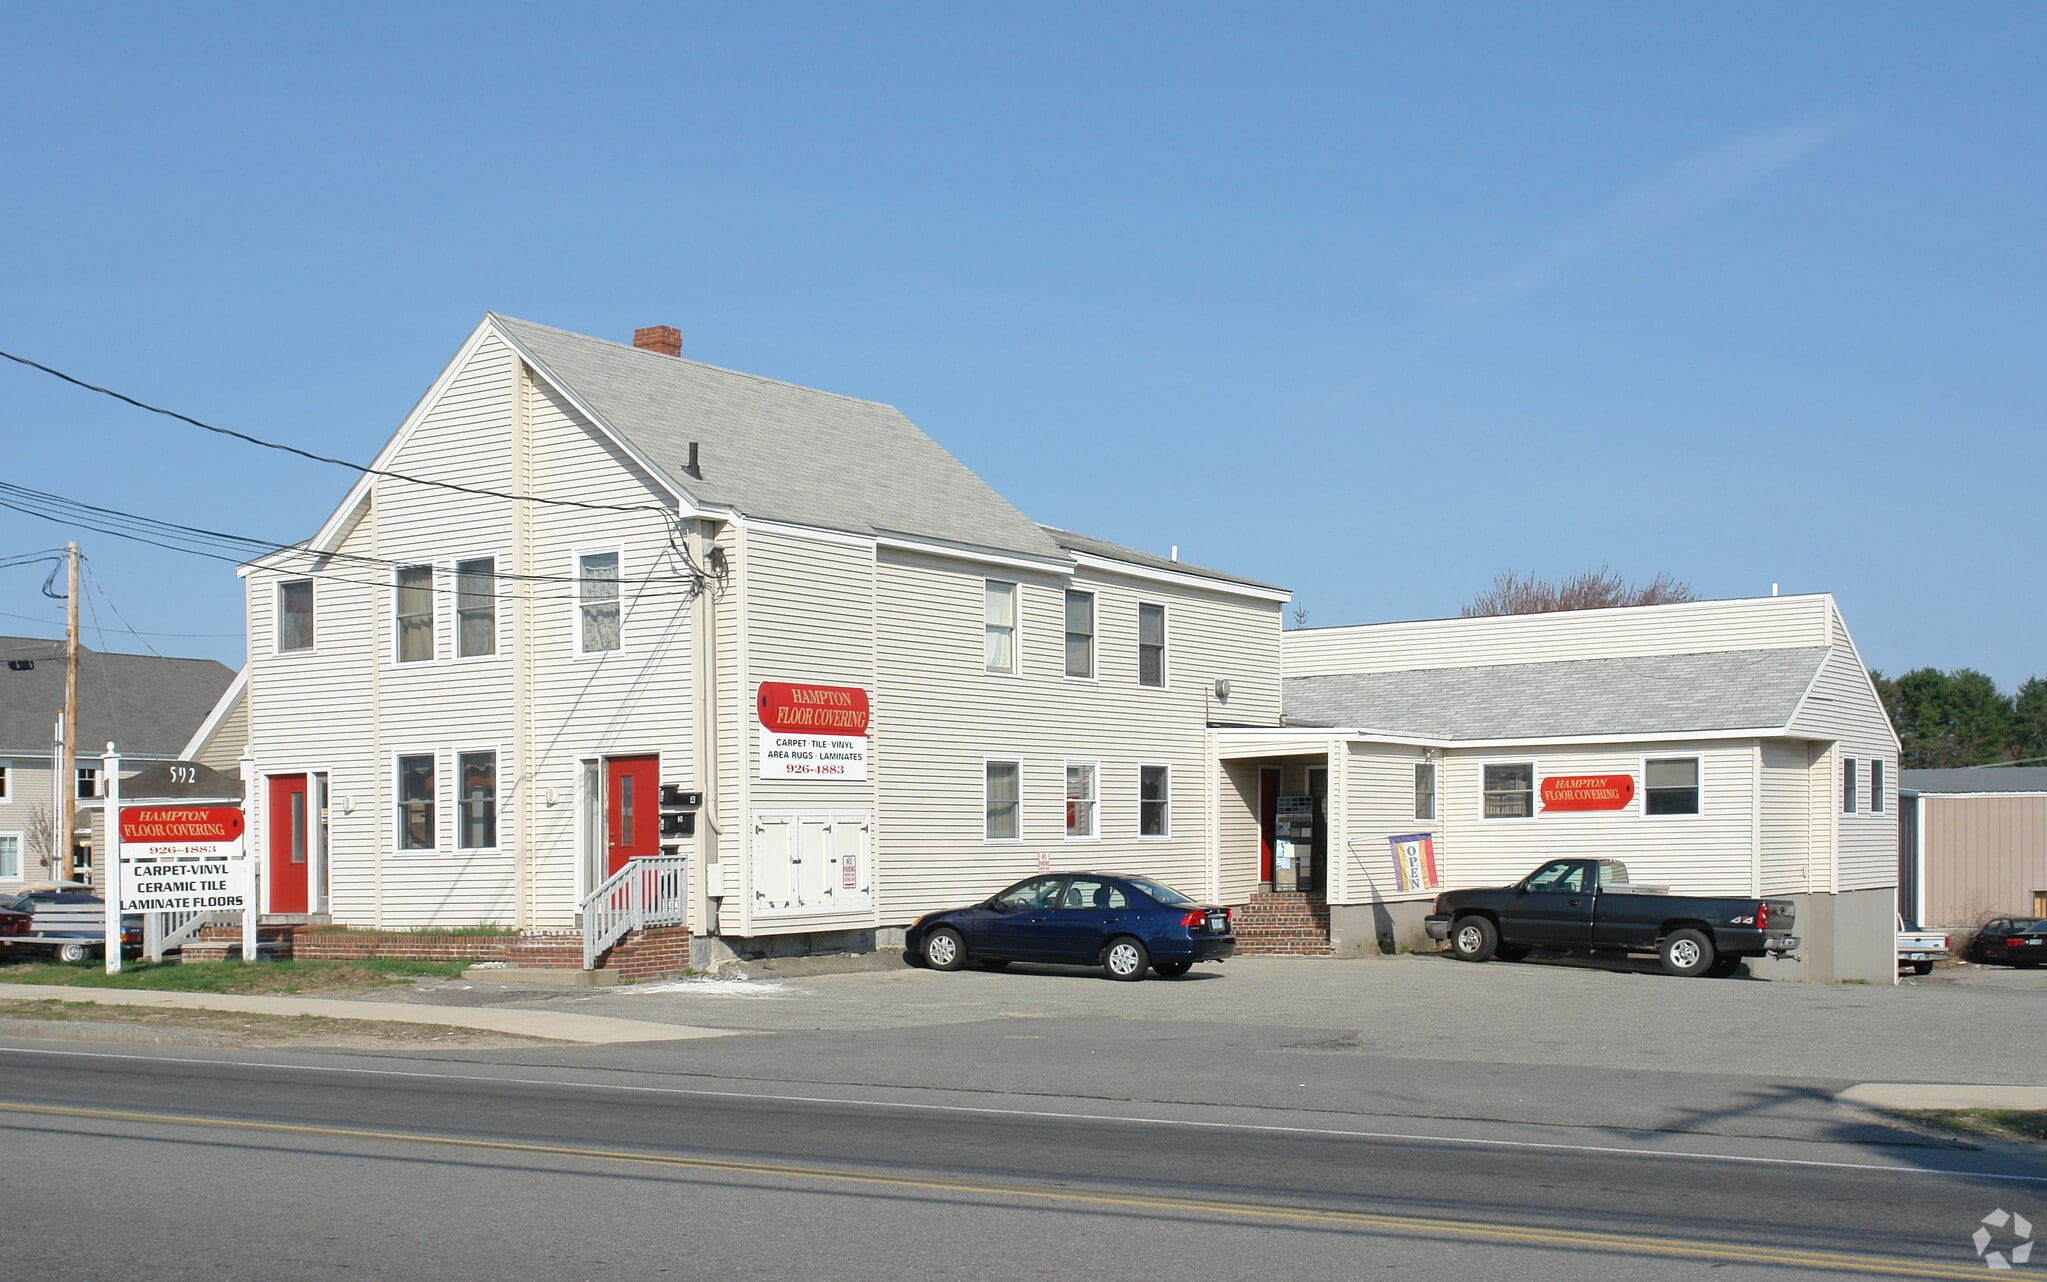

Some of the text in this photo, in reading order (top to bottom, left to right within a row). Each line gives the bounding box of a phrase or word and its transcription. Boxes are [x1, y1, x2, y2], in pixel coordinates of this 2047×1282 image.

[791, 688, 852, 706] HAMPTON
[776, 706, 866, 728] FLOOR COVERING
[776, 738, 854, 749] CARPET TILE VINYL
[767, 750, 863, 761] AREA RUGS LAMINATES
[170, 766, 195, 783] 592
[786, 763, 845, 774] 926-4883
[1555, 778, 1608, 789] HAMPTON
[1544, 788, 1620, 801] FLOOR COVERING
[138, 811, 210, 822] HAMPTON
[123, 823, 225, 837] FLOOR COVERING
[134, 864, 229, 876] CARPET-VINYL
[1407, 845, 1420, 889] OPEN
[137, 880, 227, 893] CERAMIC TILE
[120, 896, 243, 910] LAMINATE FLOORS
